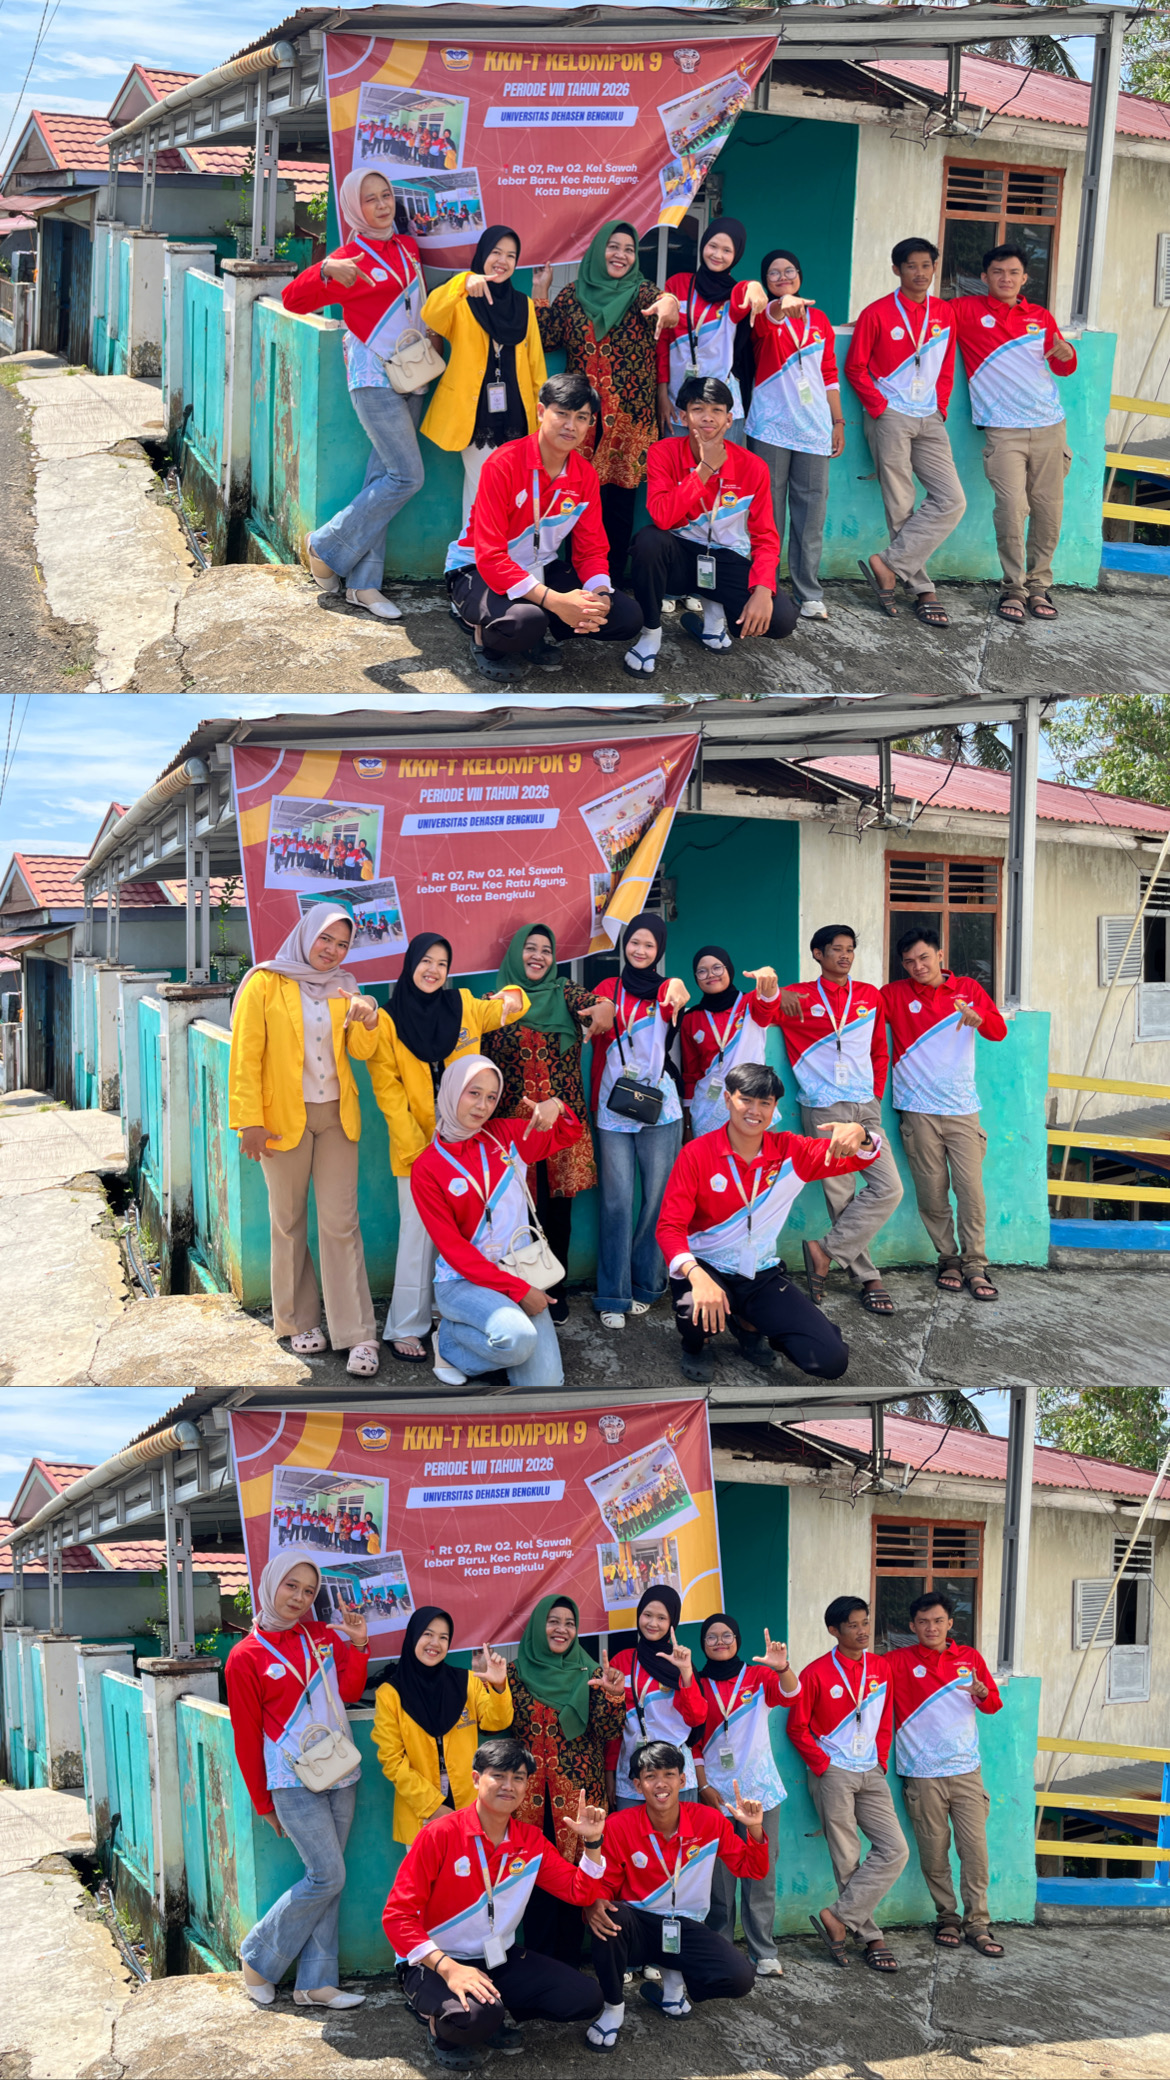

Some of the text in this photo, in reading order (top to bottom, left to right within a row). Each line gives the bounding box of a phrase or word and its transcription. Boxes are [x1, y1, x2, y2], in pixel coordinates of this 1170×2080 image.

[484, 51, 540, 71] KKN-T
[545, 53, 645, 71] KELOMPOK
[649, 52, 663, 72] 9
[503, 82, 630, 97] PERIODE VIII TAHUN 2026
[501, 112, 624, 121] UNIVERSITAS DEHASEN BENGKULU
[512, 165, 525, 173] Rt
[547, 164, 563, 173] Rw
[605, 164, 637, 172] Sawah
[530, 176, 558, 184] Baru.
[561, 176, 580, 184] Kec
[583, 176, 606, 184] Ratu
[535, 187, 609, 197] Kota Bengkulu
[398, 759, 458, 778] KKN-T
[462, 754, 564, 776] KELOMPOK
[569, 753, 582, 773] 9
[419, 785, 549, 803] PERIODE VIII TAHUN 2026
[418, 814, 544, 829] UNIVERSITAS DEHASEN BENGKULU
[432, 873, 445, 881] Rt
[467, 870, 485, 879] Rw
[528, 866, 563, 875] Sawah
[450, 883, 479, 892] Baru.
[482, 881, 502, 890] Kec
[506, 879, 530, 888] Ratu
[456, 890, 535, 903] Kota Bengkulu
[403, 1426, 462, 1450] KKN-T
[467, 1422, 569, 1448] KELOMPOK
[574, 1421, 587, 1444] 9
[424, 1457, 554, 1476] PERIODE VIII TAHUN 2026
[424, 1486, 550, 1502] UNIVERSITAS DEHASEN BENGKULU
[439, 1546, 452, 1555] Rt
[475, 1544, 492, 1552] Rw
[536, 1537, 571, 1548] Sawah
[458, 1557, 487, 1565] Baru.
[490, 1554, 510, 1563] Kec
[514, 1553, 538, 1561] Ratu
[464, 1563, 544, 1577] Kota Bengkulu
